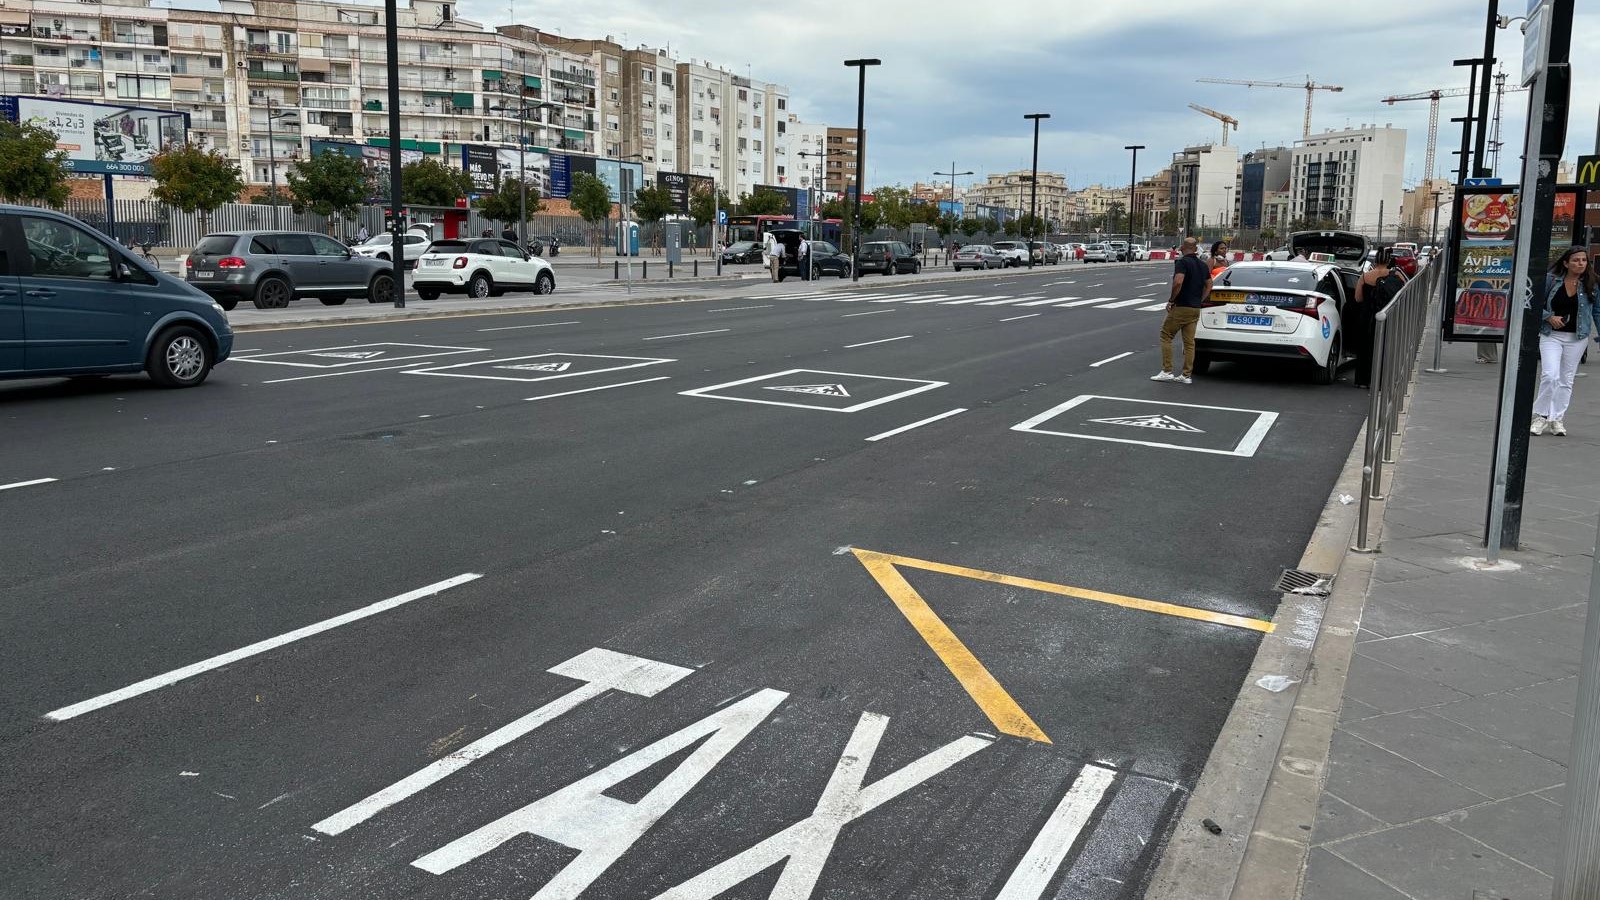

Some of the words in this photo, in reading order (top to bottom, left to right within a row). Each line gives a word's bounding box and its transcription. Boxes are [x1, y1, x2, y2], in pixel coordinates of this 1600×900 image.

[66, 117, 72, 128] 2
[78, 118, 85, 129] 3
[470, 162, 482, 172] MÁS
[665, 175, 683, 183] GINOS
[719, 211, 726, 224] P
[1463, 252, 1501, 267] Ávila
[1485, 267, 1512, 275] destin
[1232, 316, 1253, 325] 4590
[311, 647, 1117, 900] TAXI
